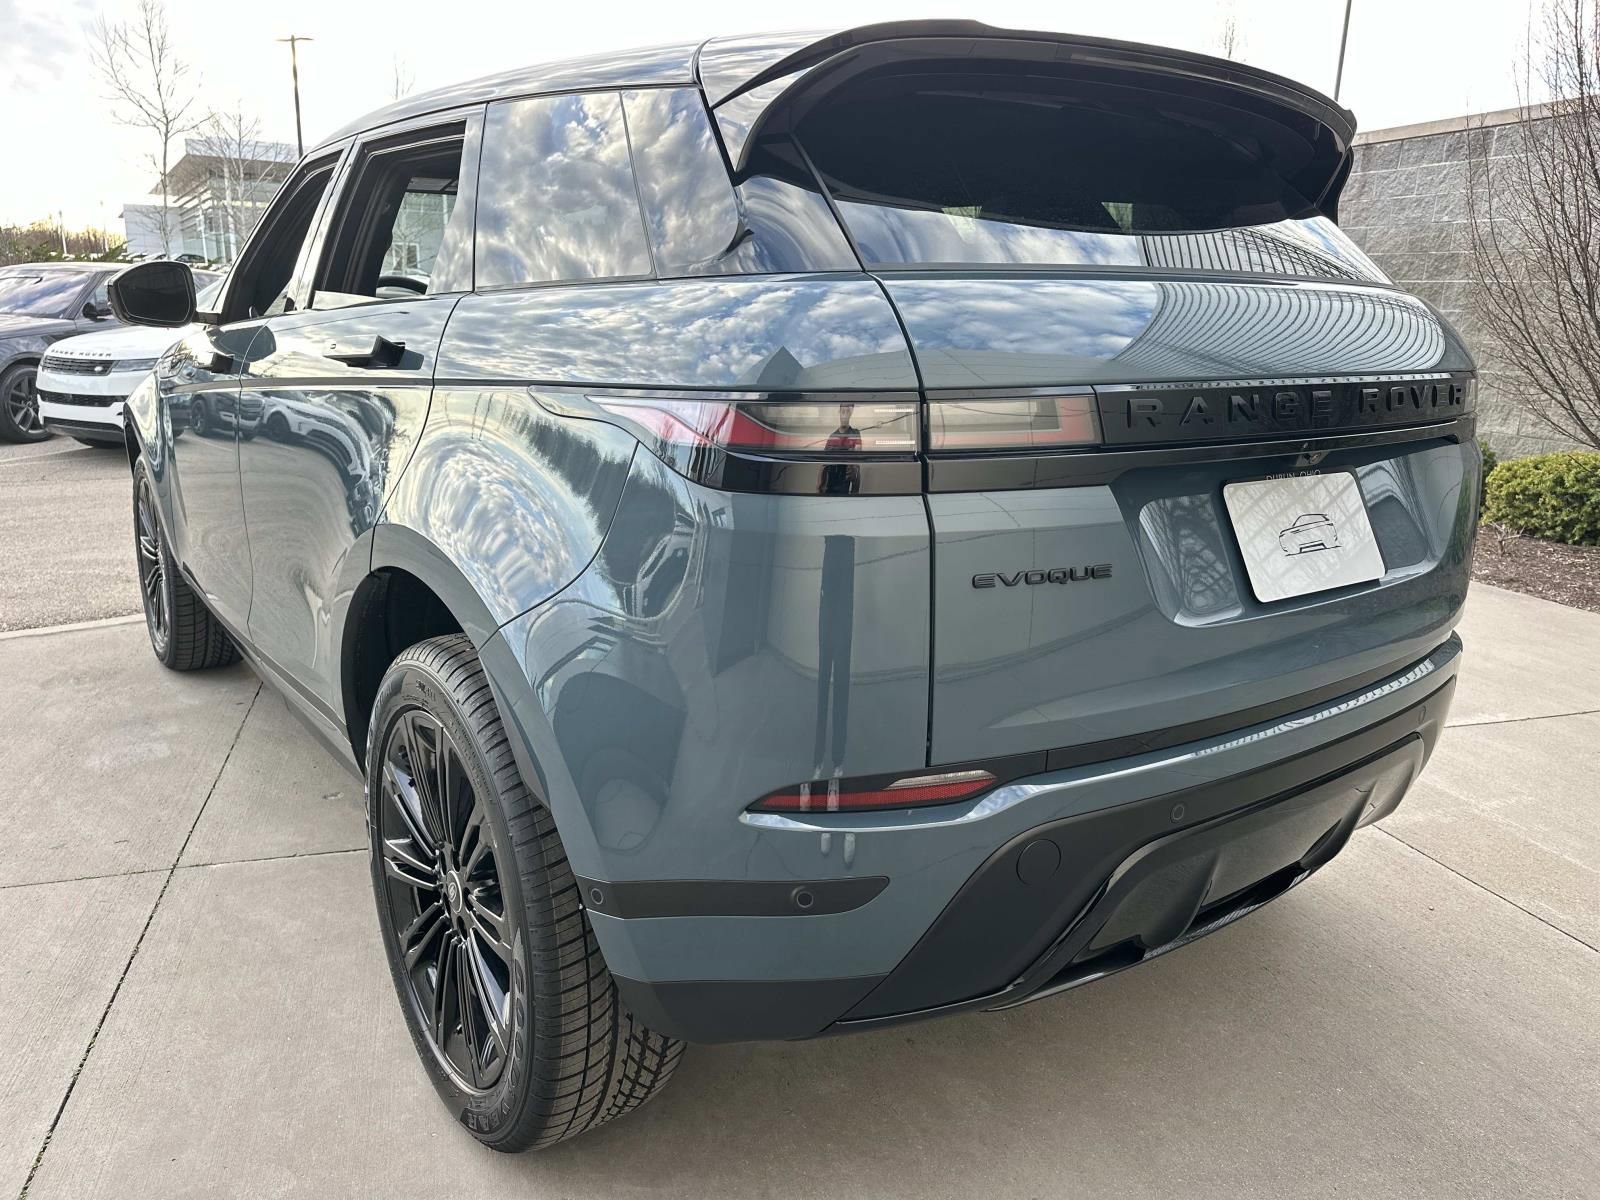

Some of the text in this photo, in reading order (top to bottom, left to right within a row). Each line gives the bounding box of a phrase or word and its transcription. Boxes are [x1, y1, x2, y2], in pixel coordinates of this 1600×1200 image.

[1127, 384, 1464, 428] RANGE ROVER
[971, 563, 1113, 589] EVOQUE
